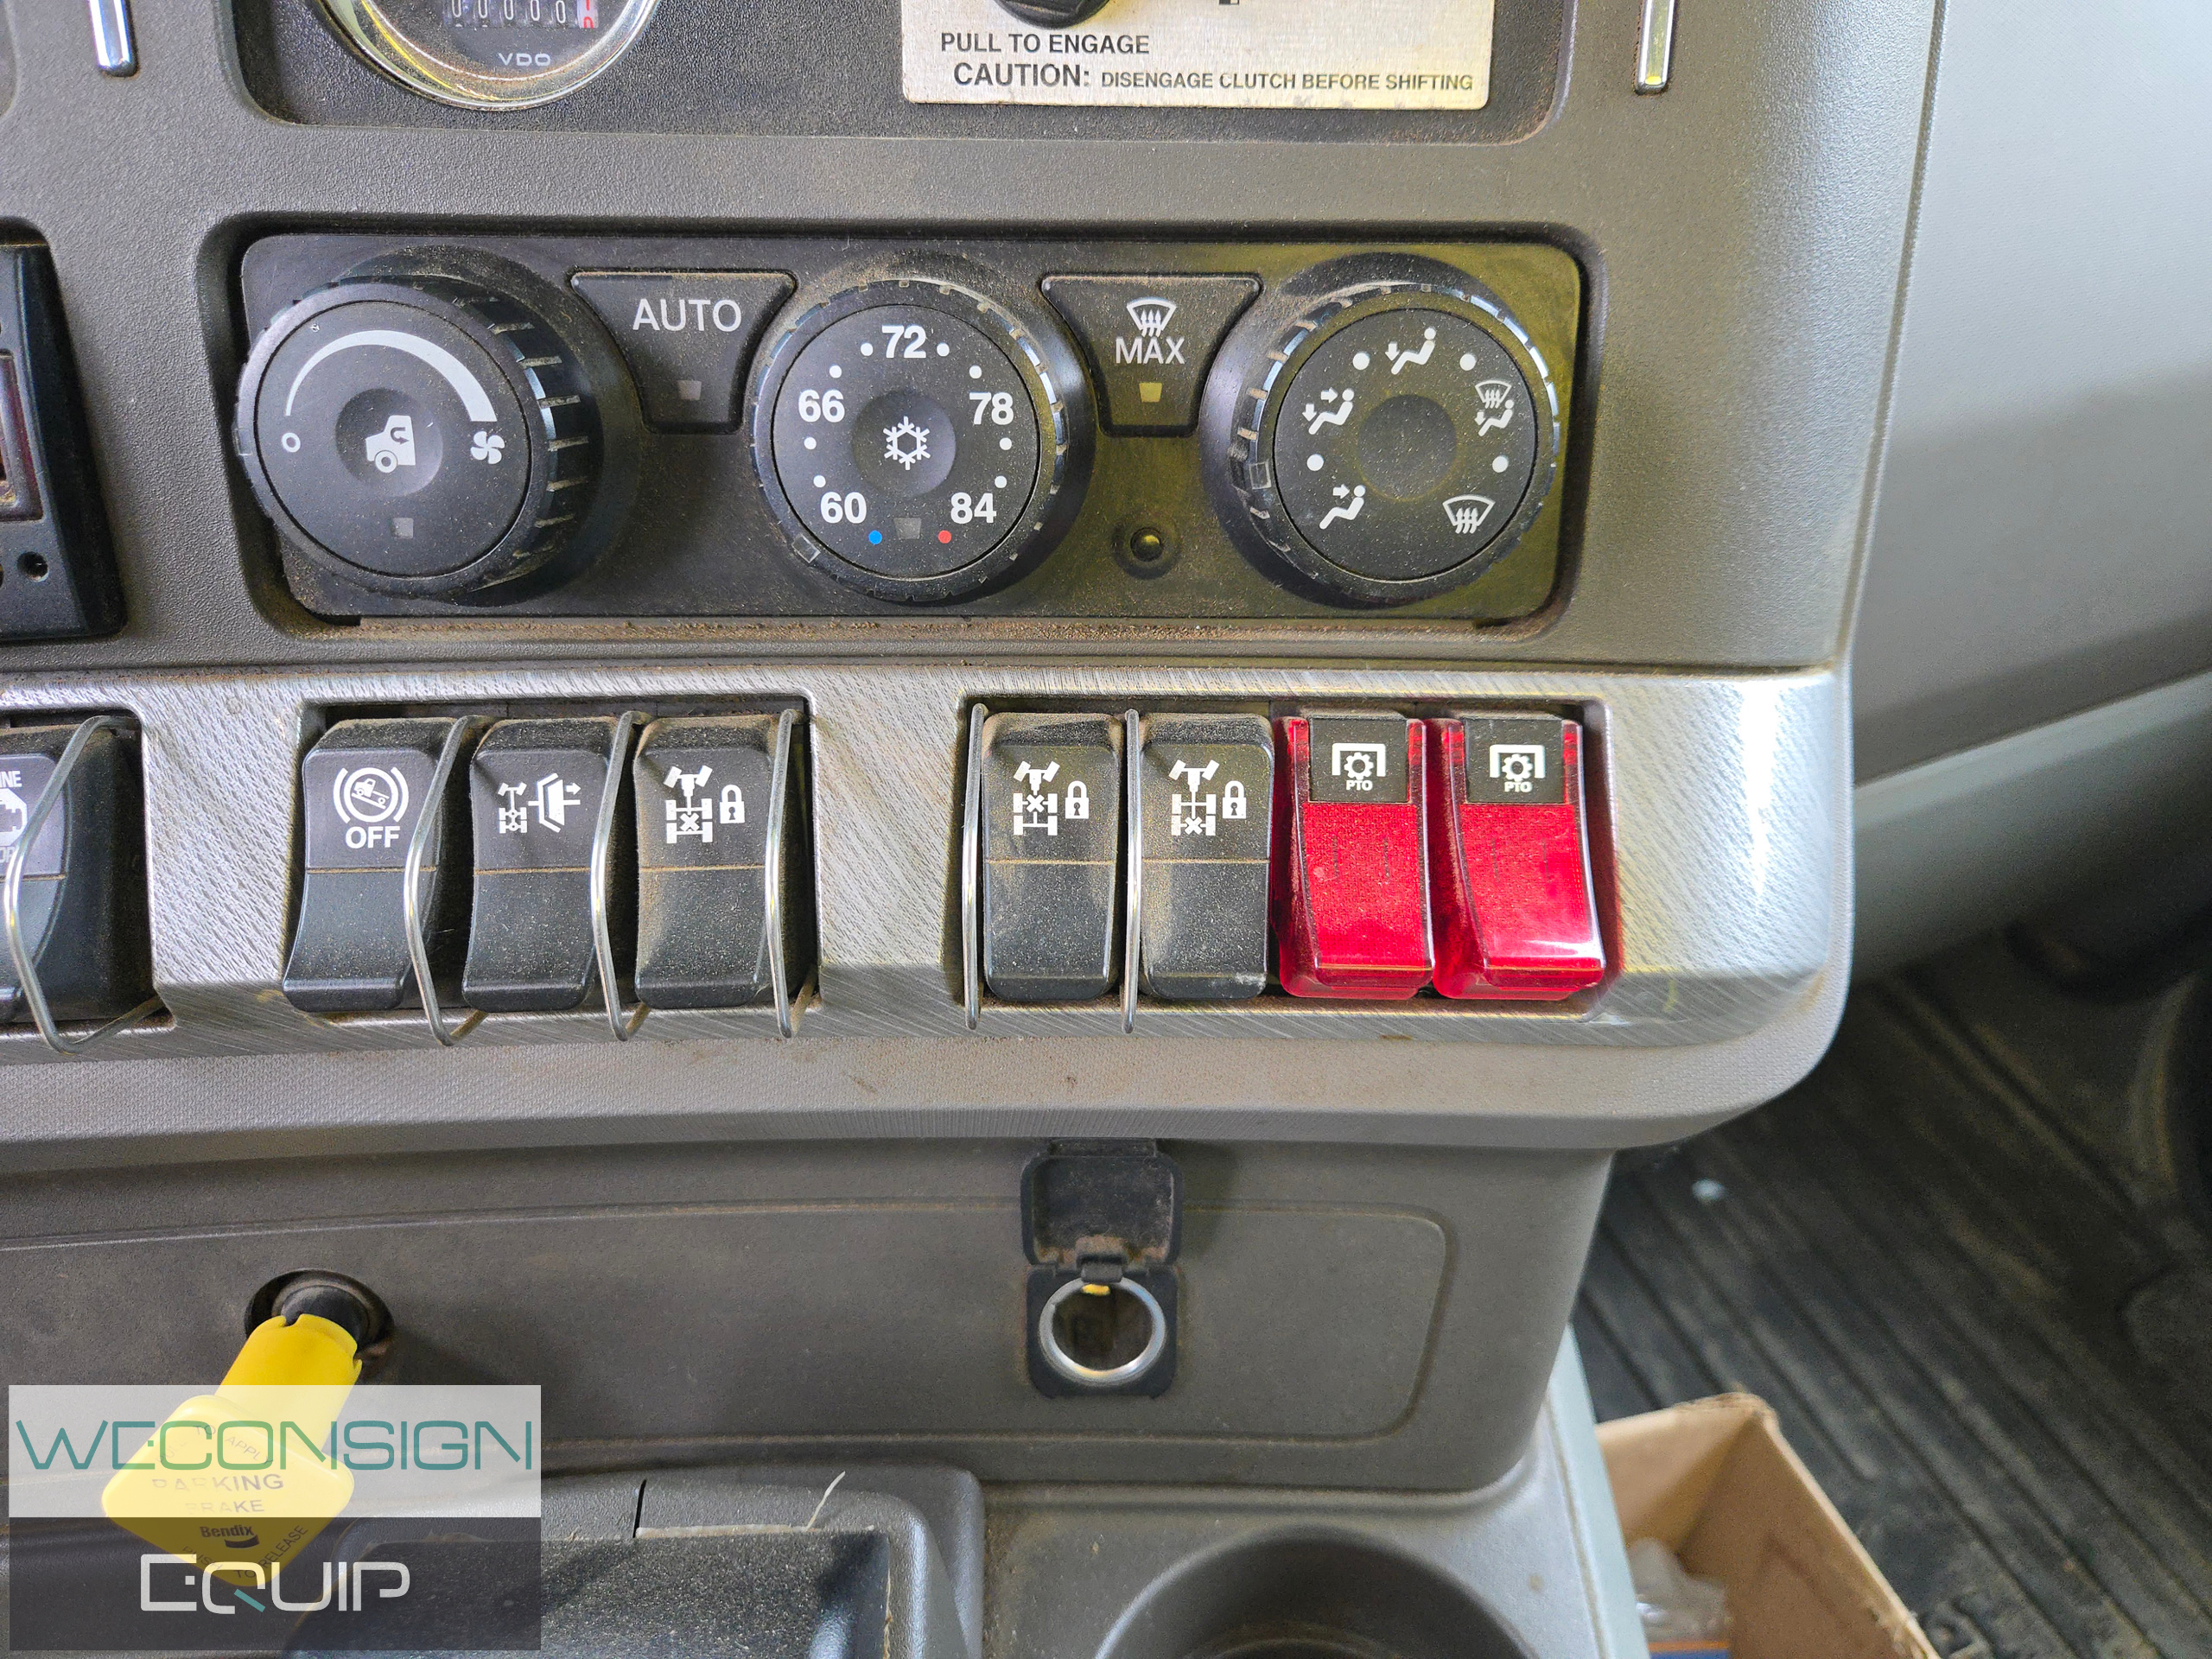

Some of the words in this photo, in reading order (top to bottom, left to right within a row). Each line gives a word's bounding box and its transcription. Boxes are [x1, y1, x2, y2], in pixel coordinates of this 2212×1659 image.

[940, 33, 1001, 53] PULL
[1008, 34, 1040, 53] TO
[1049, 35, 1149, 54] ENGAGE
[498, 53, 551, 67] VDO
[954, 62, 1090, 86] CAUTION:
[1102, 72, 1212, 89] DISENGAGE
[1219, 73, 1296, 89] CLUTCH
[1302, 74, 1380, 90] BEFORE
[1386, 74, 1473, 91] SHIFTING
[632, 299, 742, 332] AUTO
[881, 325, 927, 359] 72
[1116, 337, 1185, 365] MAX
[798, 390, 845, 423] 66
[969, 392, 1014, 425] 78
[820, 492, 867, 524] 60
[950, 493, 997, 524] 84
[1346, 779, 1373, 791] PTO
[1504, 781, 1533, 792] PTO
[346, 826, 401, 849] OFF
[225, 1436, 274, 1465] APPLY
[200, 1524, 255, 1538] Bendix
[259, 1525, 308, 1569] RELEASE
